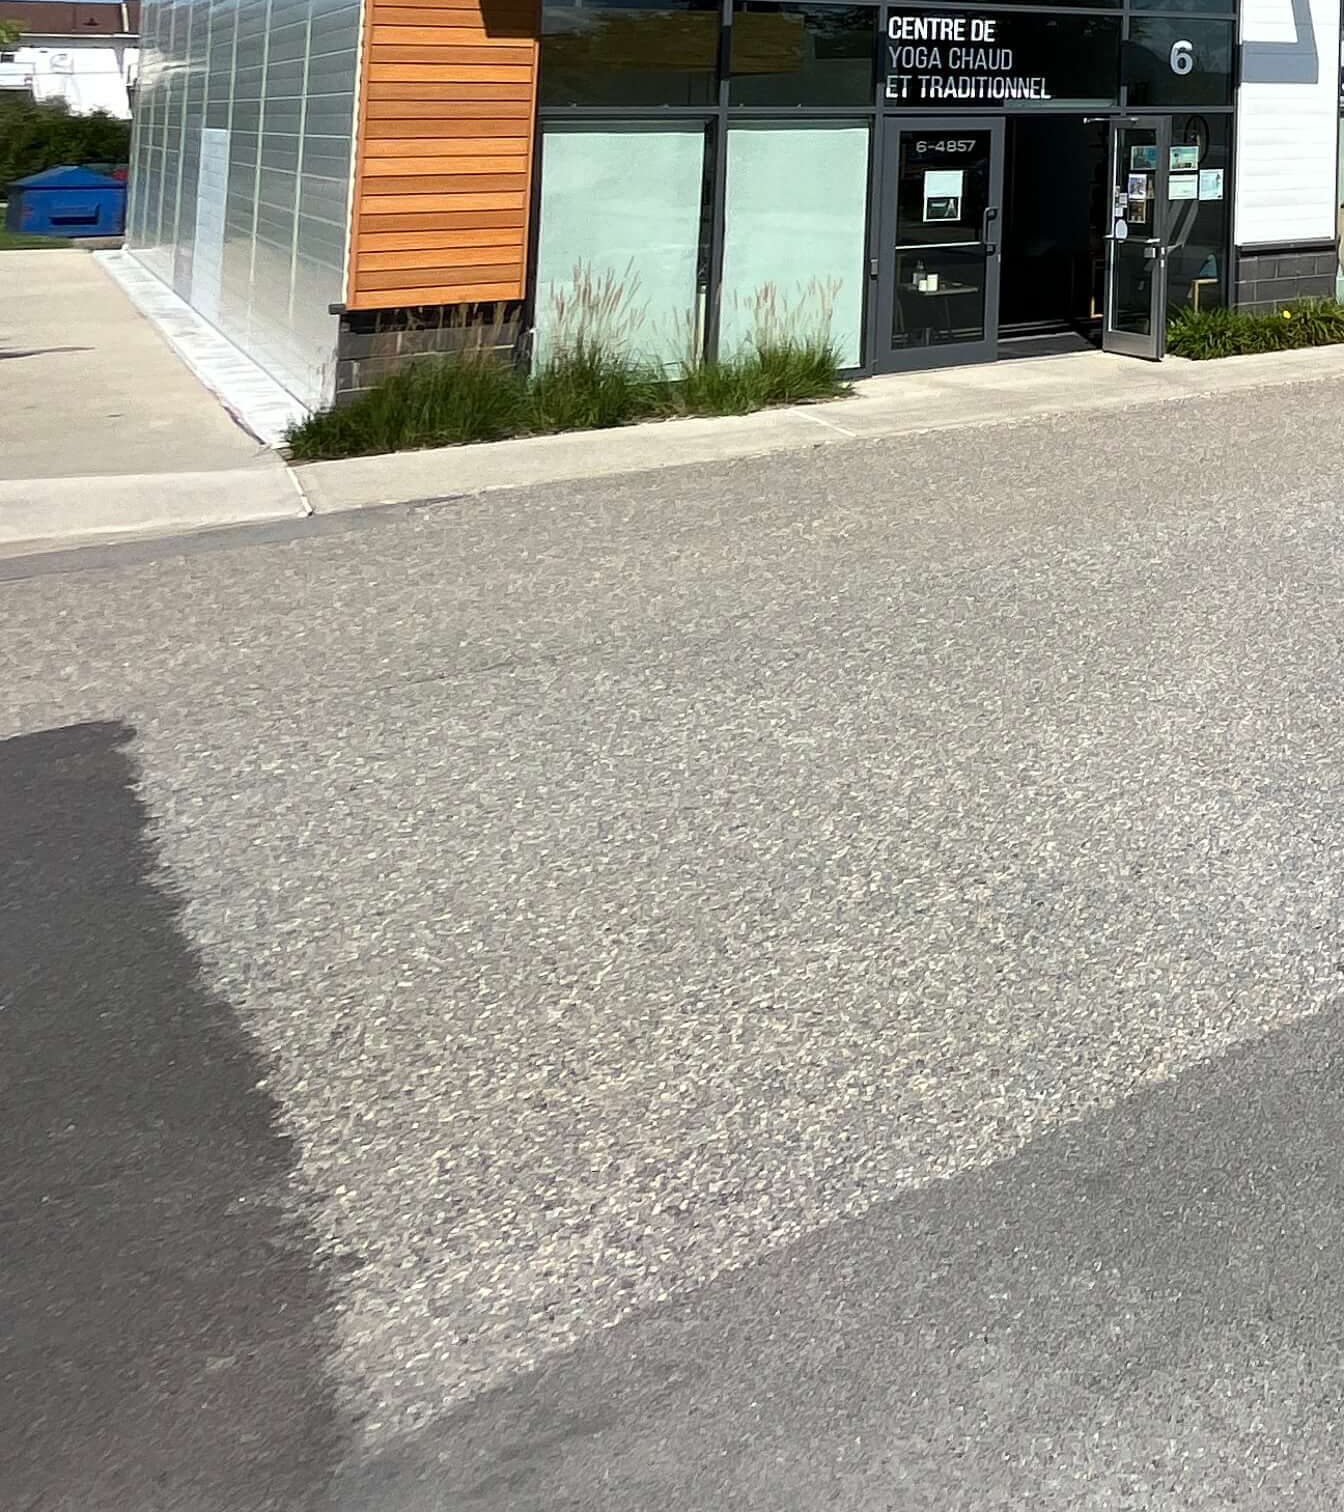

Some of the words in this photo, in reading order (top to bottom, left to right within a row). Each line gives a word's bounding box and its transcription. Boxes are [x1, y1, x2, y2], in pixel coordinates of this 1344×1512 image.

[888, 16, 965, 41] CENTRE
[970, 19, 996, 42] DE
[889, 46, 942, 69] YOGA
[948, 47, 1013, 70] CHAUD
[1169, 40, 1193, 75] 6
[886, 75, 912, 98] ET
[917, 75, 1051, 99] TRADITIONNEL
[916, 140, 976, 153] 6-4857
